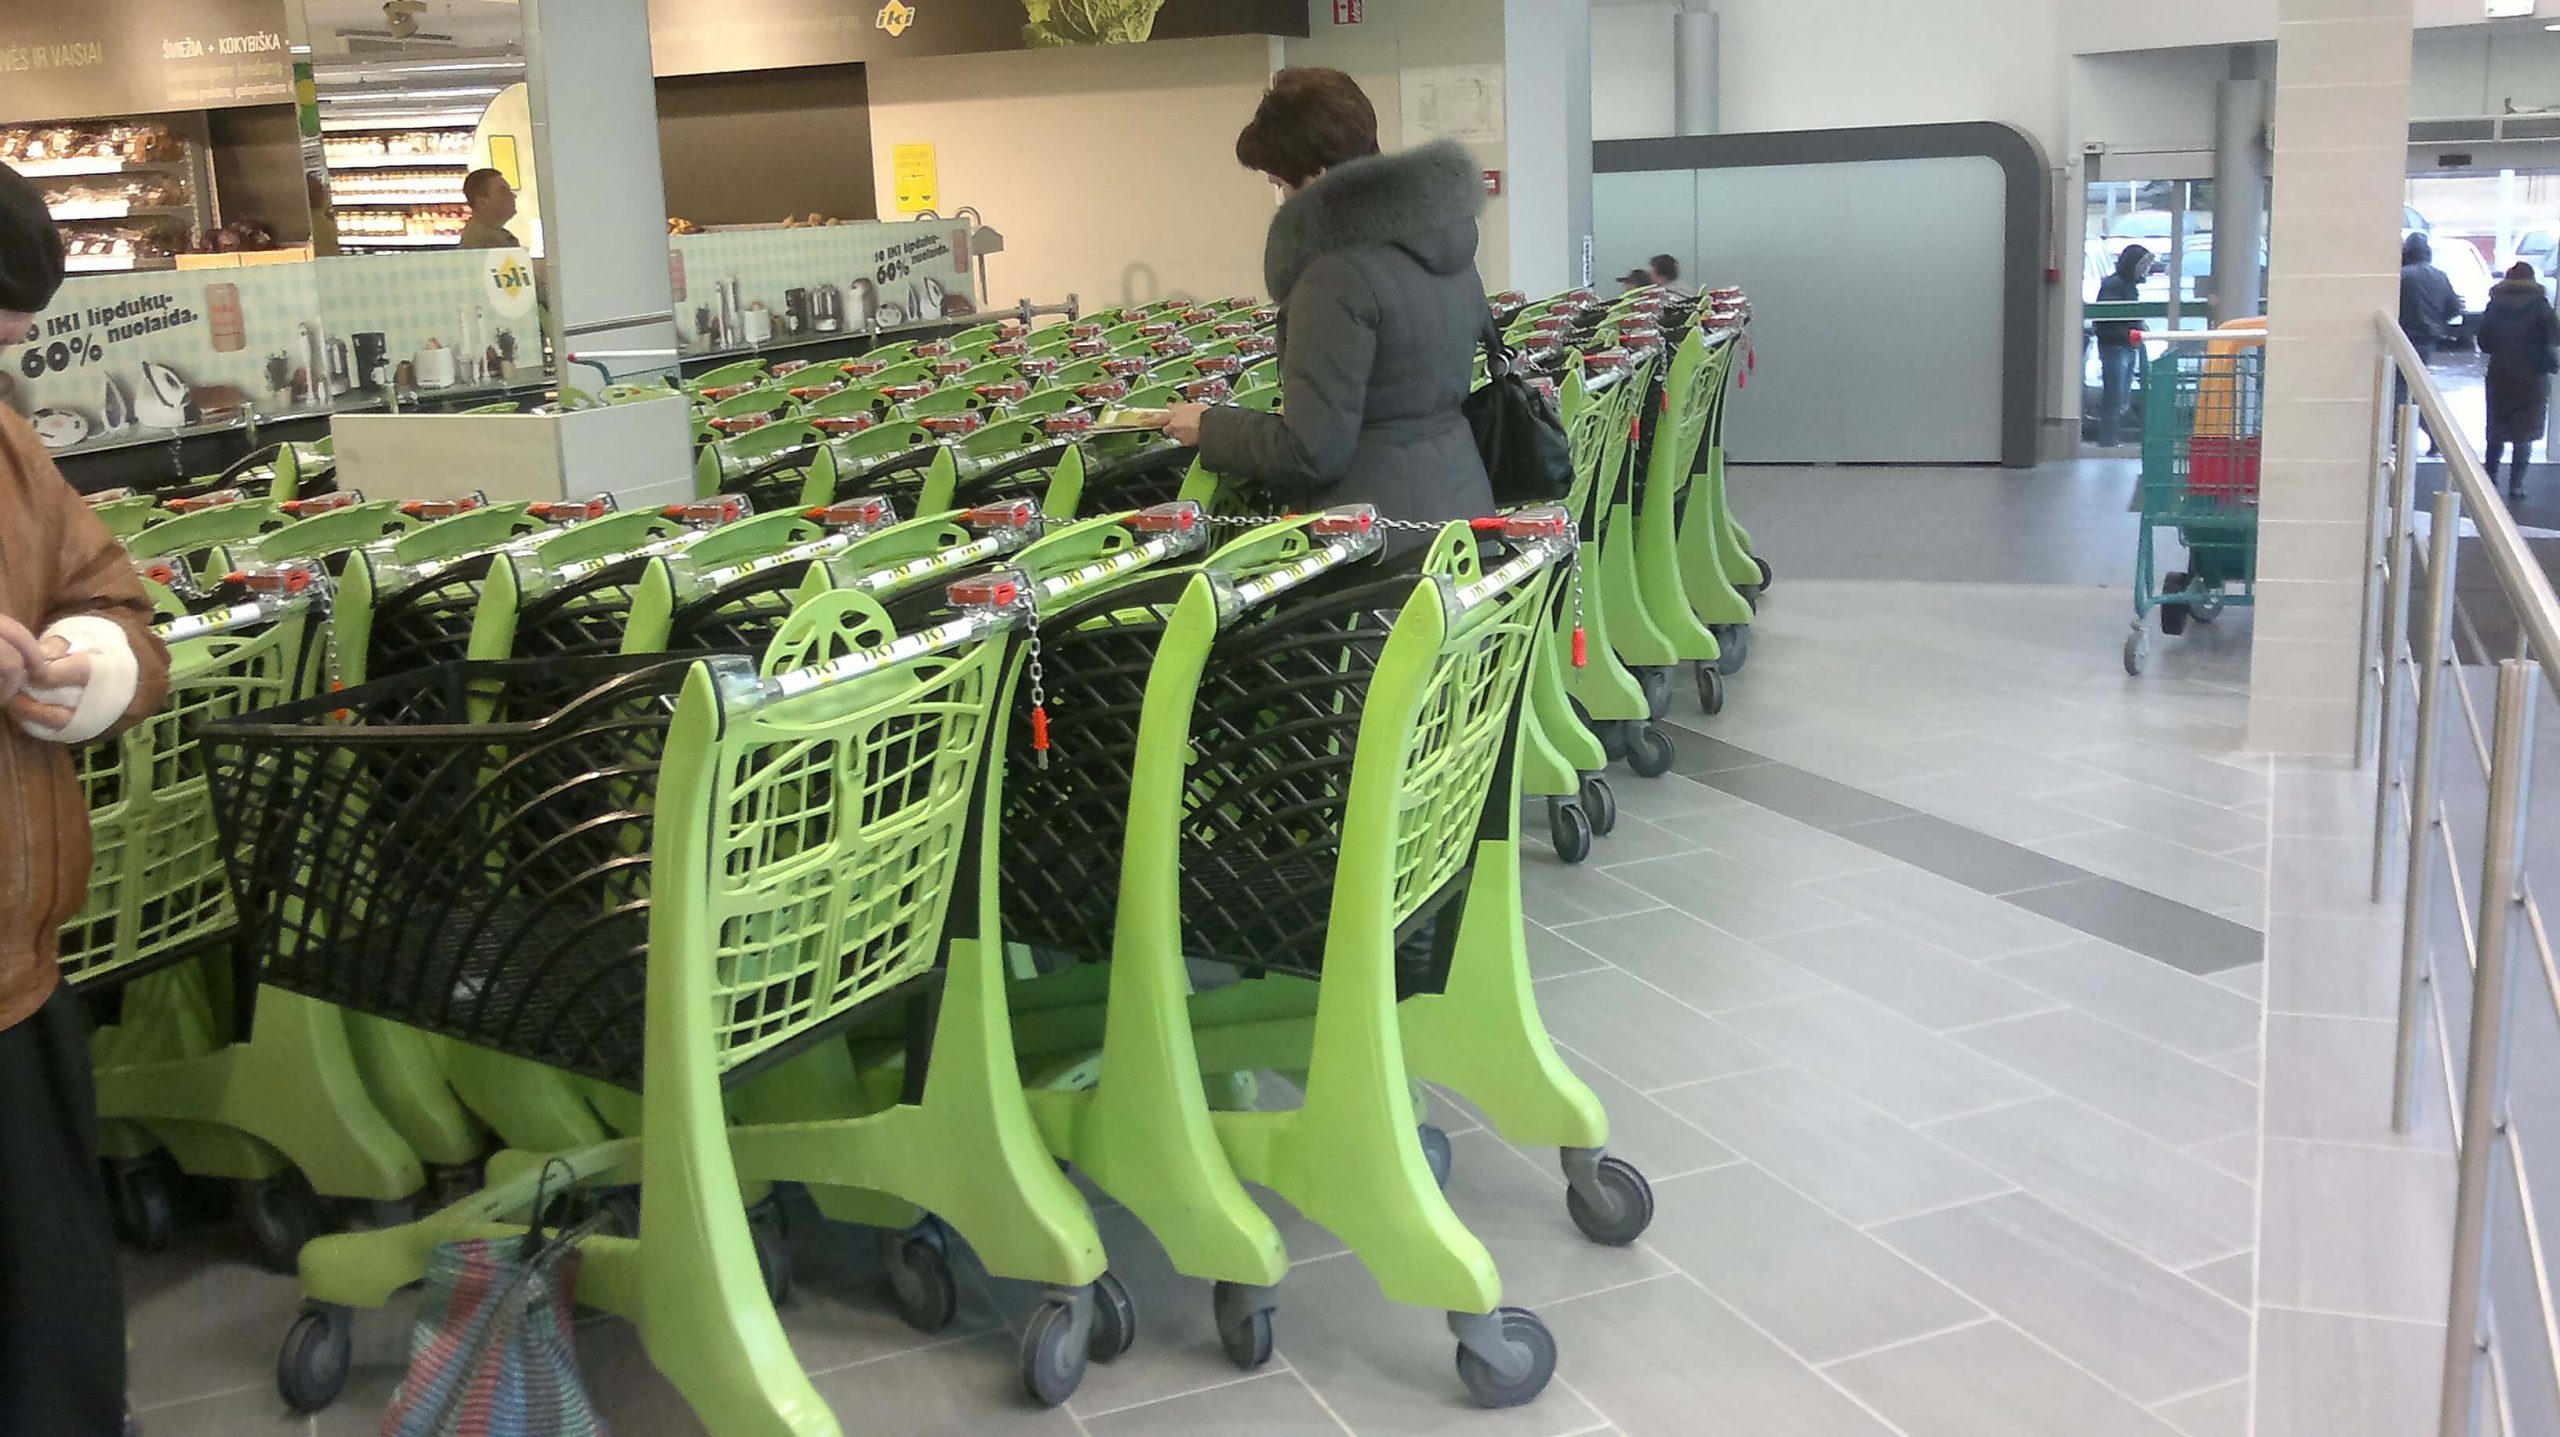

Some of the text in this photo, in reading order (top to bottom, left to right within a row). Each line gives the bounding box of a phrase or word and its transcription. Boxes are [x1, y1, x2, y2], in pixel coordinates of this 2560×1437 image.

[219, 31, 281, 54] KOKYBIŠKA
[877, 260, 910, 285] 60%
[46, 312, 81, 337] IKI
[20, 307, 199, 379] 60% nuolaida.
